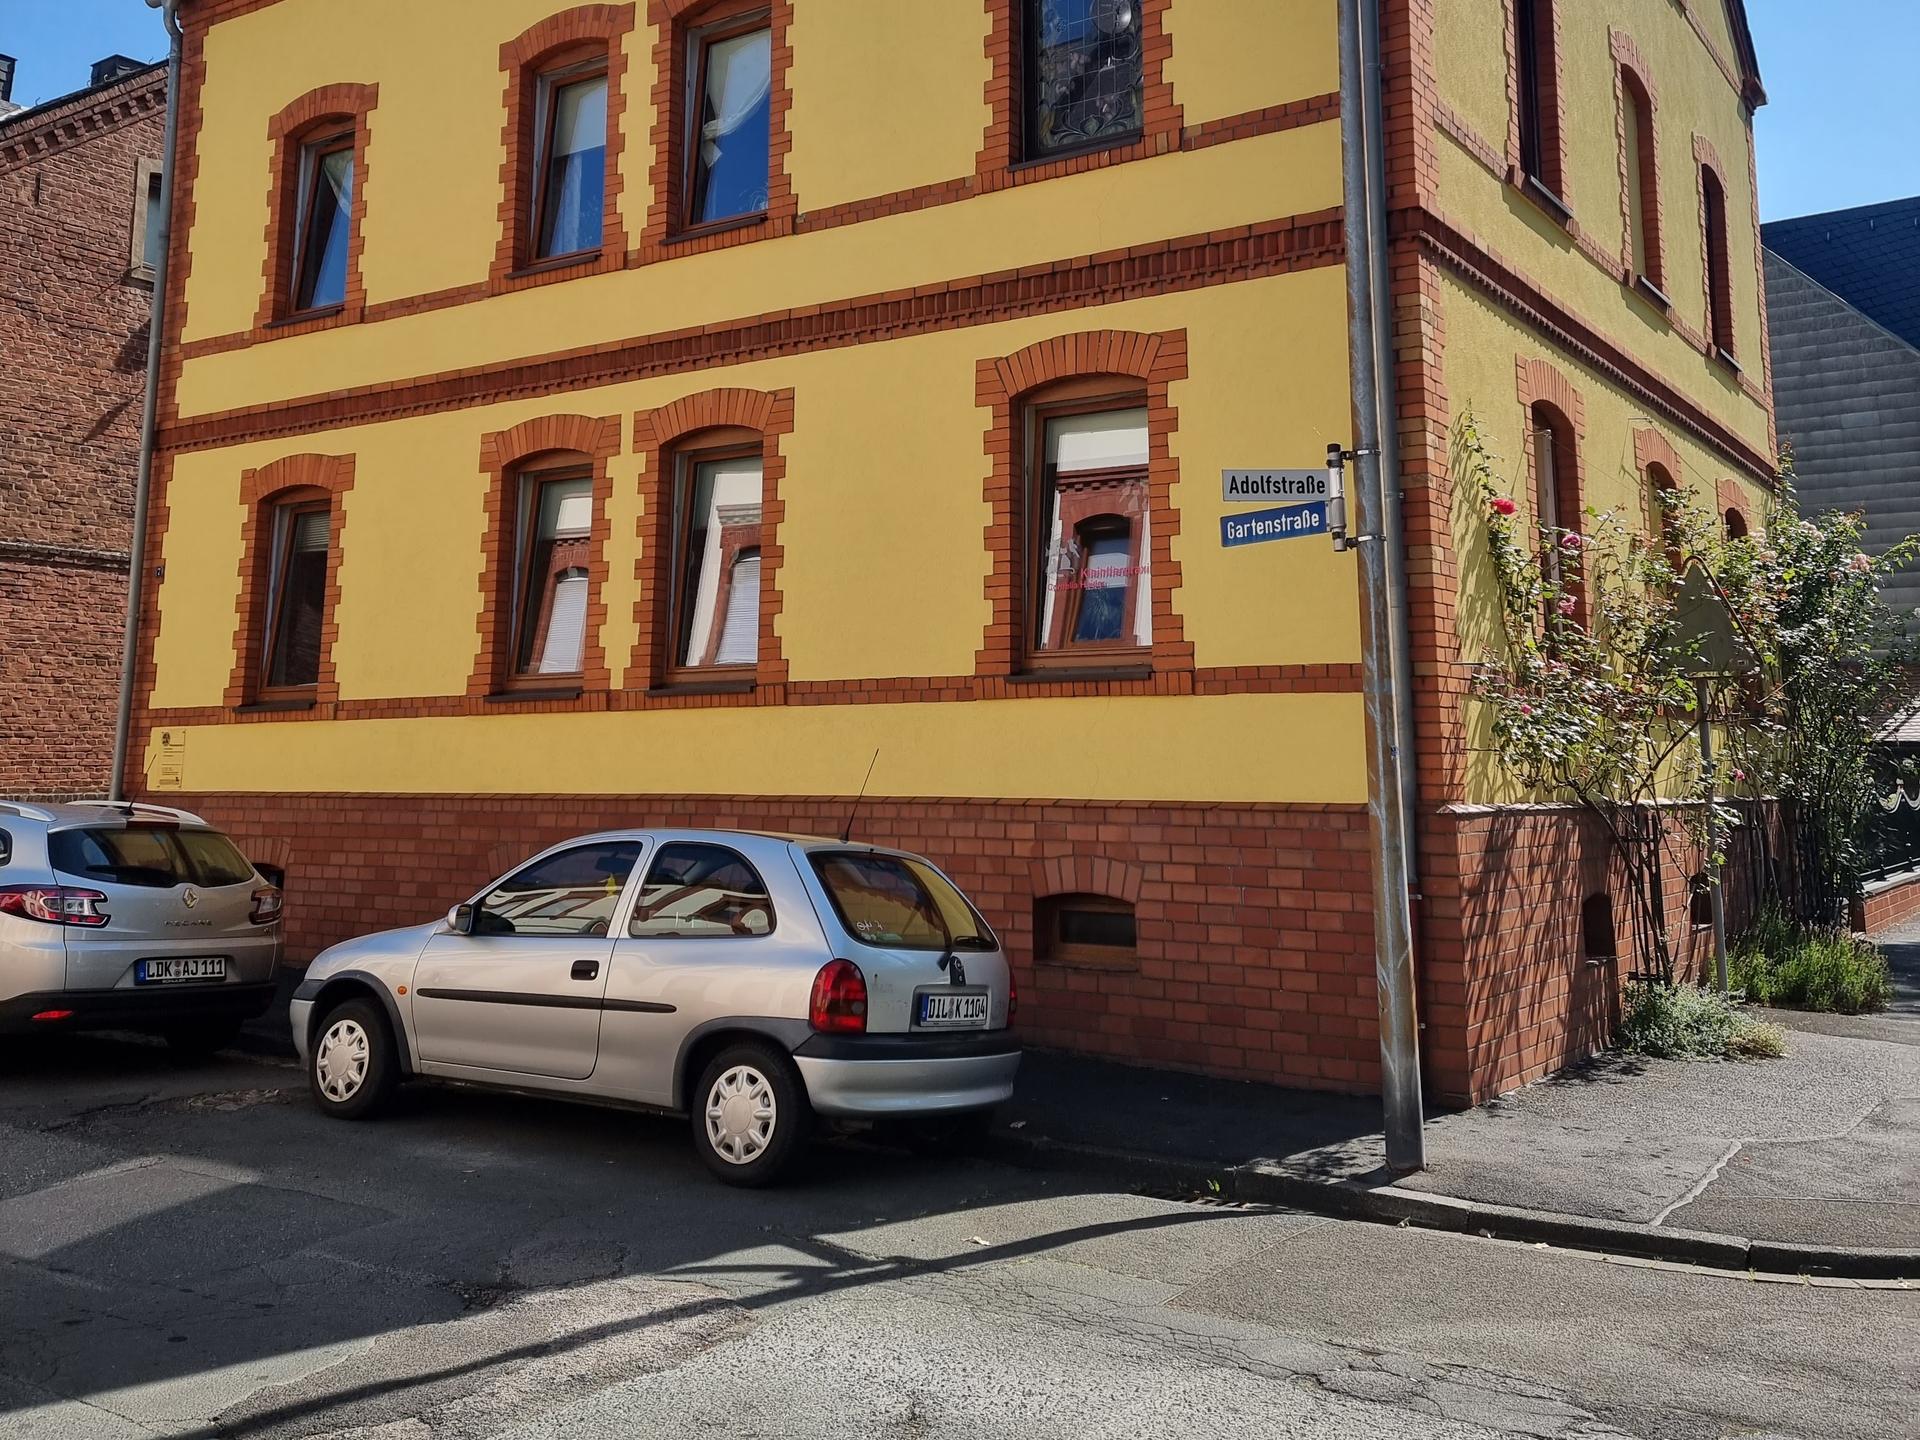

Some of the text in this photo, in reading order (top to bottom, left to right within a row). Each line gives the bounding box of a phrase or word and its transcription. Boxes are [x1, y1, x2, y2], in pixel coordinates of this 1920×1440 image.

[1229, 475, 1326, 494] Adolfstraße
[1227, 510, 1320, 539] Gartenstraße
[147, 959, 224, 978] LDK AJ 111
[928, 998, 985, 1019] DIL K 1104
